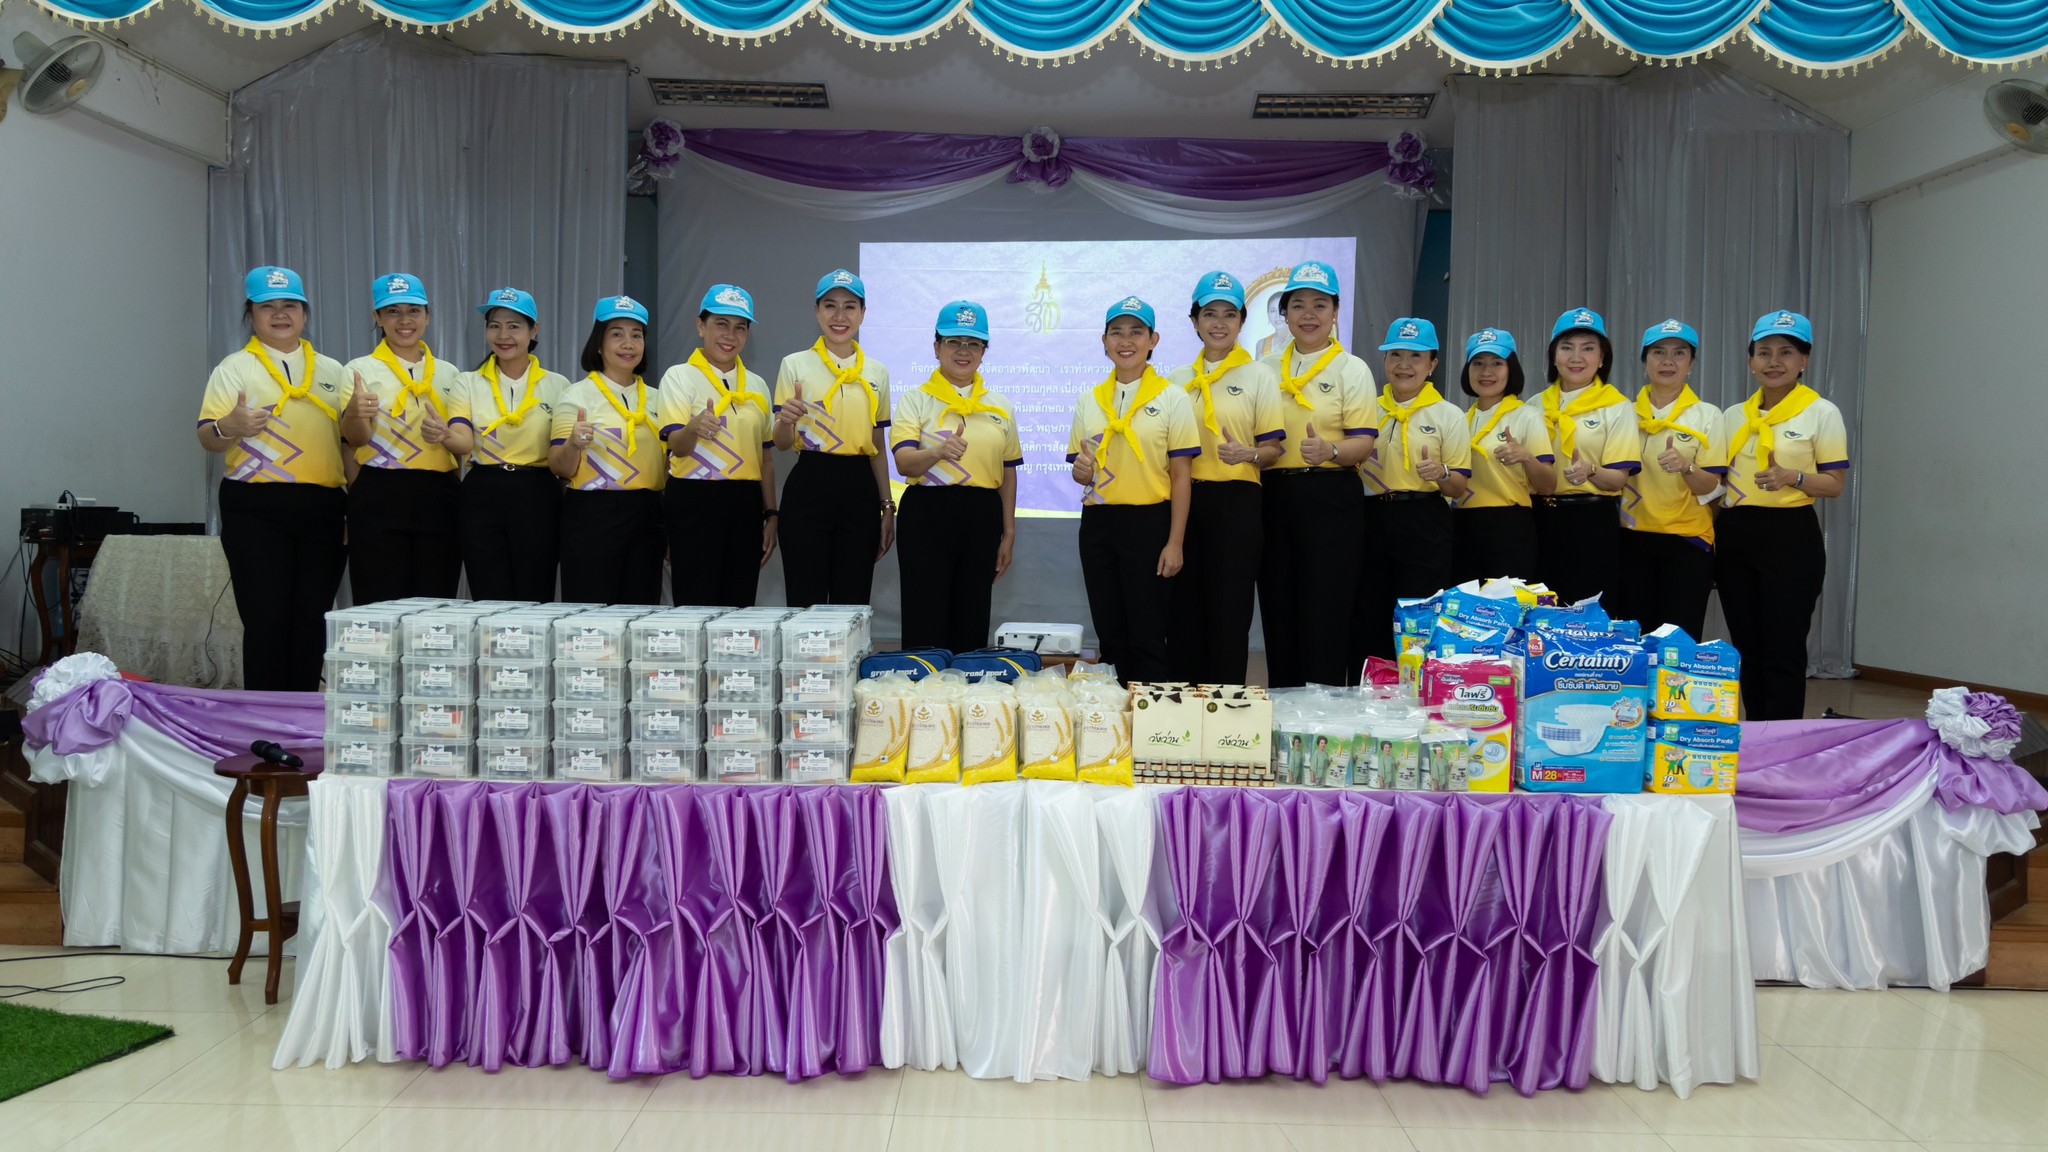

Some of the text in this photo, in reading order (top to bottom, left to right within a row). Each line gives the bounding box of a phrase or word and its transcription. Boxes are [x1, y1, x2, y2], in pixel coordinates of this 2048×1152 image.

[979, 361, 1051, 375] รจิตอาสาพัฒนา
[1036, 423, 1071, 435] พฤษภา
[1544, 650, 1631, 673] Certainty
[1717, 665, 1735, 673] Pants
[1532, 770, 1543, 780] M
[1544, 770, 1558, 780] 28
